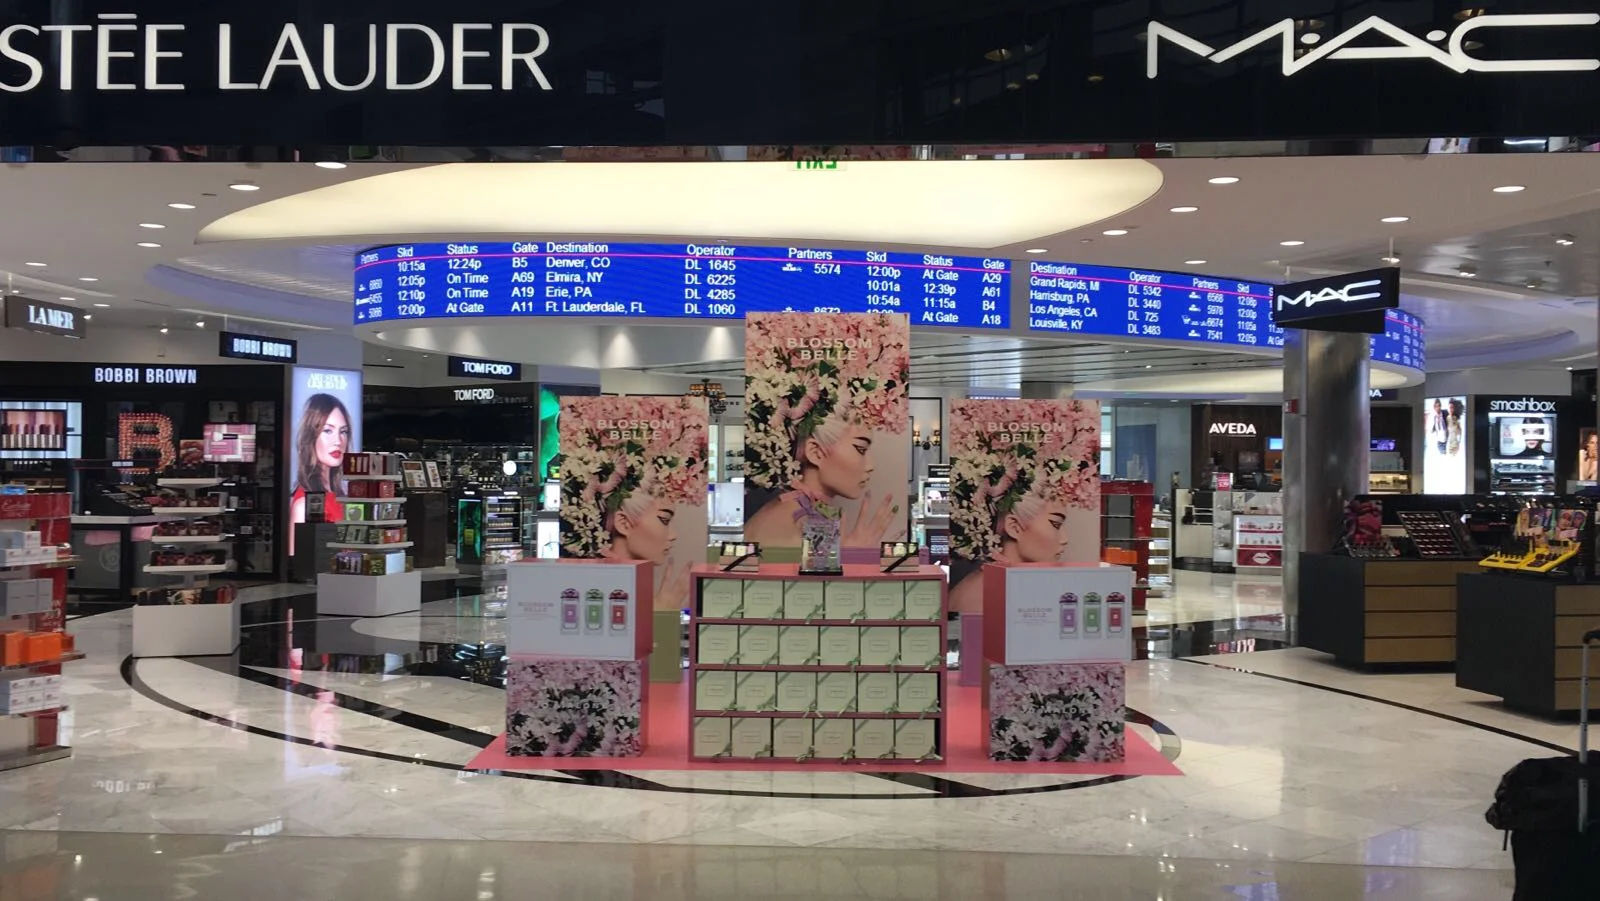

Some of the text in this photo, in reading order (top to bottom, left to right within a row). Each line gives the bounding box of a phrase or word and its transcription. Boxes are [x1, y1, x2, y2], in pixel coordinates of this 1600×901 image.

[219, 23, 553, 90] LAUDER
[397, 247, 413, 258] Skd
[447, 244, 478, 254] Status
[512, 242, 538, 253] Gate
[546, 242, 608, 253] Destination
[687, 244, 736, 257] Operator
[788, 248, 832, 260] Partners
[866, 252, 887, 262] Skd
[923, 254, 953, 266] Status
[983, 259, 1005, 270] Gate
[397, 257, 1002, 283] 10:15a 12:24p B5 Denver, CO DL 1645 5574 12:00p At Gate A29
[1030, 262, 1077, 275] Destination
[1129, 272, 1161, 284] Operator
[1193, 278, 1219, 290] Partners
[397, 275, 425, 287] 12:05p
[447, 273, 462, 284] On
[464, 273, 488, 283] Time
[511, 272, 534, 283] A69
[546, 271, 583, 284] Elmira,
[587, 272, 603, 283] NY
[685, 274, 702, 284] DL
[707, 274, 736, 285] 6225
[866, 281, 900, 292] 10:01a
[923, 283, 956, 295] 12:39p
[982, 286, 1001, 297] A61
[1030, 276, 1058, 288] Grand
[1059, 279, 1088, 292] Rapids,
[1128, 285, 1139, 295] DL
[1142, 286, 1161, 297] 5342
[397, 290, 425, 301] 12:10p
[447, 288, 462, 299] On
[464, 287, 488, 298] Time
[511, 287, 534, 297] A19
[546, 287, 571, 299] Erie,
[574, 287, 592, 297] PA
[685, 289, 702, 299] DL
[707, 289, 736, 300] 4285
[866, 295, 900, 306] 10:54a
[923, 297, 956, 309] 11:15a
[982, 300, 996, 311] B4
[1030, 290, 1073, 304] Harrisburg,
[1076, 294, 1089, 304] PA
[1128, 298, 1139, 308] DL
[1142, 299, 1161, 309] 3440
[397, 304, 425, 316] 12:00p
[446, 303, 457, 313] At
[459, 302, 485, 313] Gate
[511, 302, 533, 312] A11
[563, 302, 628, 314] Lauderdale,
[631, 302, 646, 313] FL
[685, 304, 702, 314] DL
[708, 304, 736, 315] 1060
[923, 312, 934, 322] At
[936, 313, 959, 323] Gate
[982, 315, 1001, 325] A18
[1030, 304, 1046, 315] Los
[1047, 306, 1082, 320] Angeles,
[1084, 308, 1097, 318] CA
[1128, 311, 1139, 321] DL
[1144, 312, 1158, 322] 725
[1030, 317, 1069, 330] Louisville,
[1071, 320, 1083, 330] KY
[1128, 324, 1139, 334] DL
[233, 338, 292, 358] BOBBI BROWN
[787, 337, 872, 348] BLOSSOM
[801, 350, 857, 360] BELLE
[95, 367, 196, 383] BOBBI BROWN
[462, 361, 513, 375] TOM FORD
[454, 389, 471, 401] TOM
[472, 388, 494, 400] FORD
[1490, 397, 1556, 411] smashbox
[597, 419, 674, 429] BLOSSOM
[988, 422, 1066, 432] BLOSSOM
[1209, 422, 1256, 435] AVEDA
[610, 431, 662, 440] BELLE
[1000, 434, 1053, 443] BELLE
